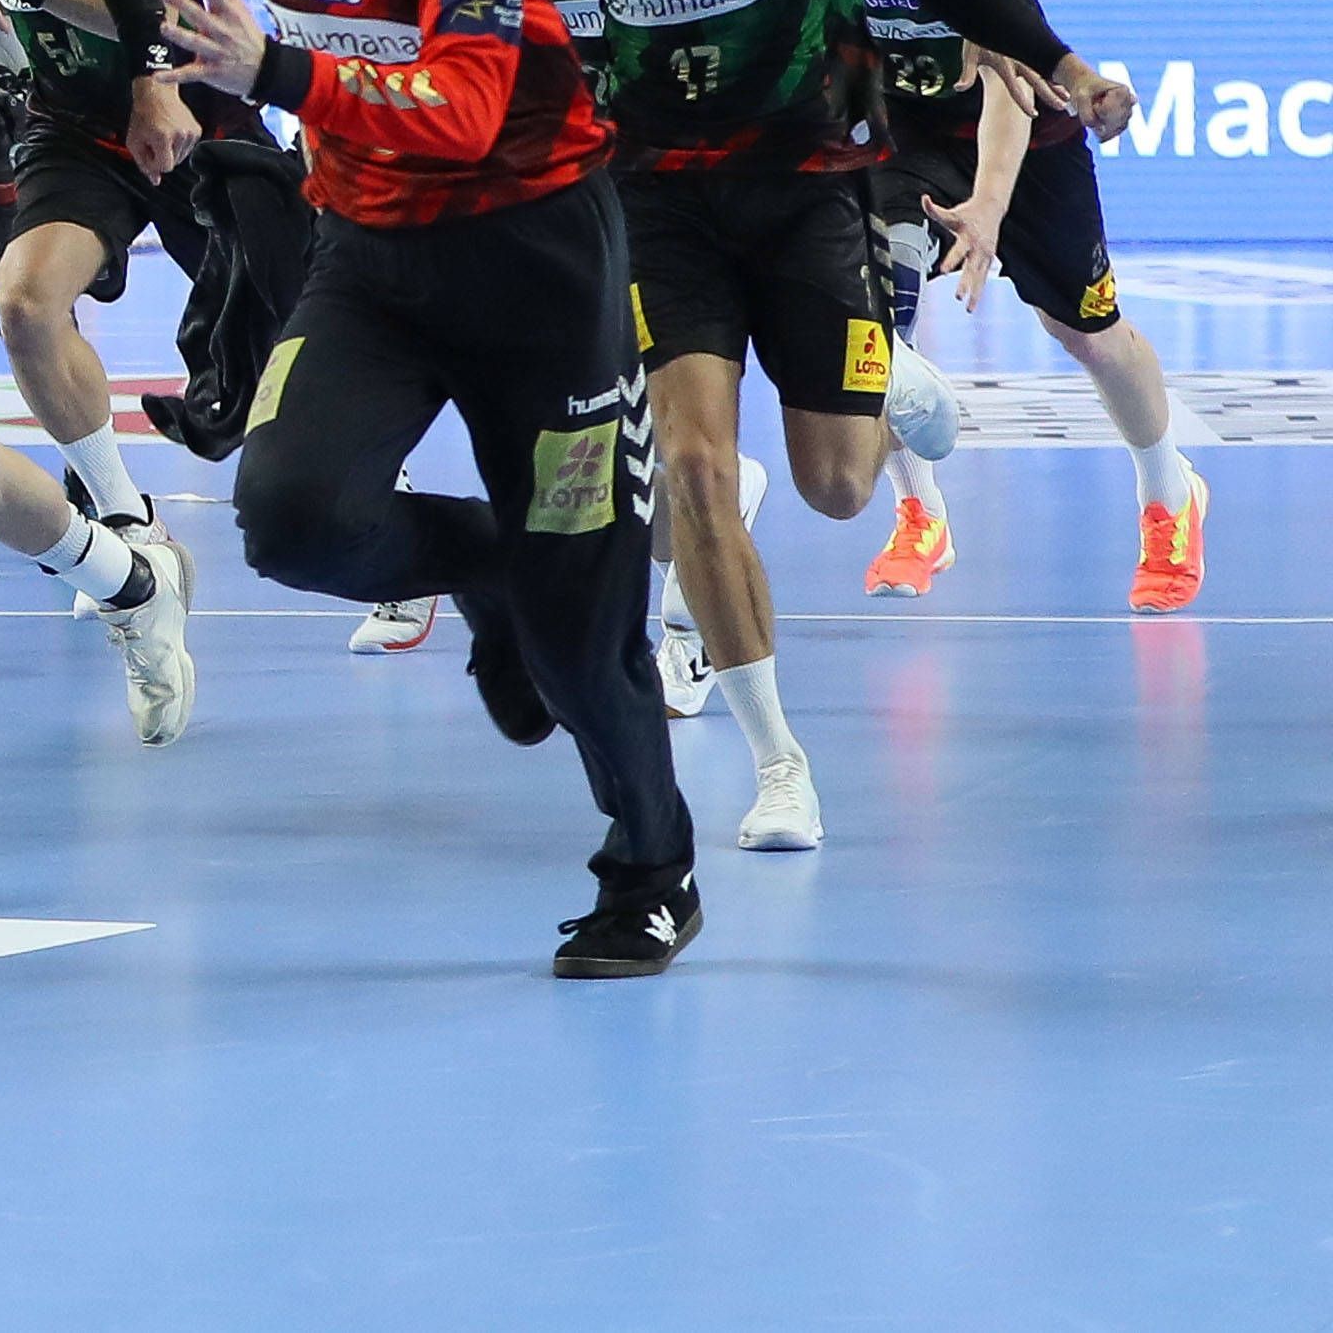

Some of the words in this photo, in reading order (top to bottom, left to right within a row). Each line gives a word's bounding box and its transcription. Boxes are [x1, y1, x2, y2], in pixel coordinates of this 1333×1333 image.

[284, 23, 420, 54] Humana
[669, 44, 721, 100] 17
[1098, 60, 1333, 158] Mac
[855, 359, 886, 375] LOTTO
[537, 483, 609, 509] LOTTO
